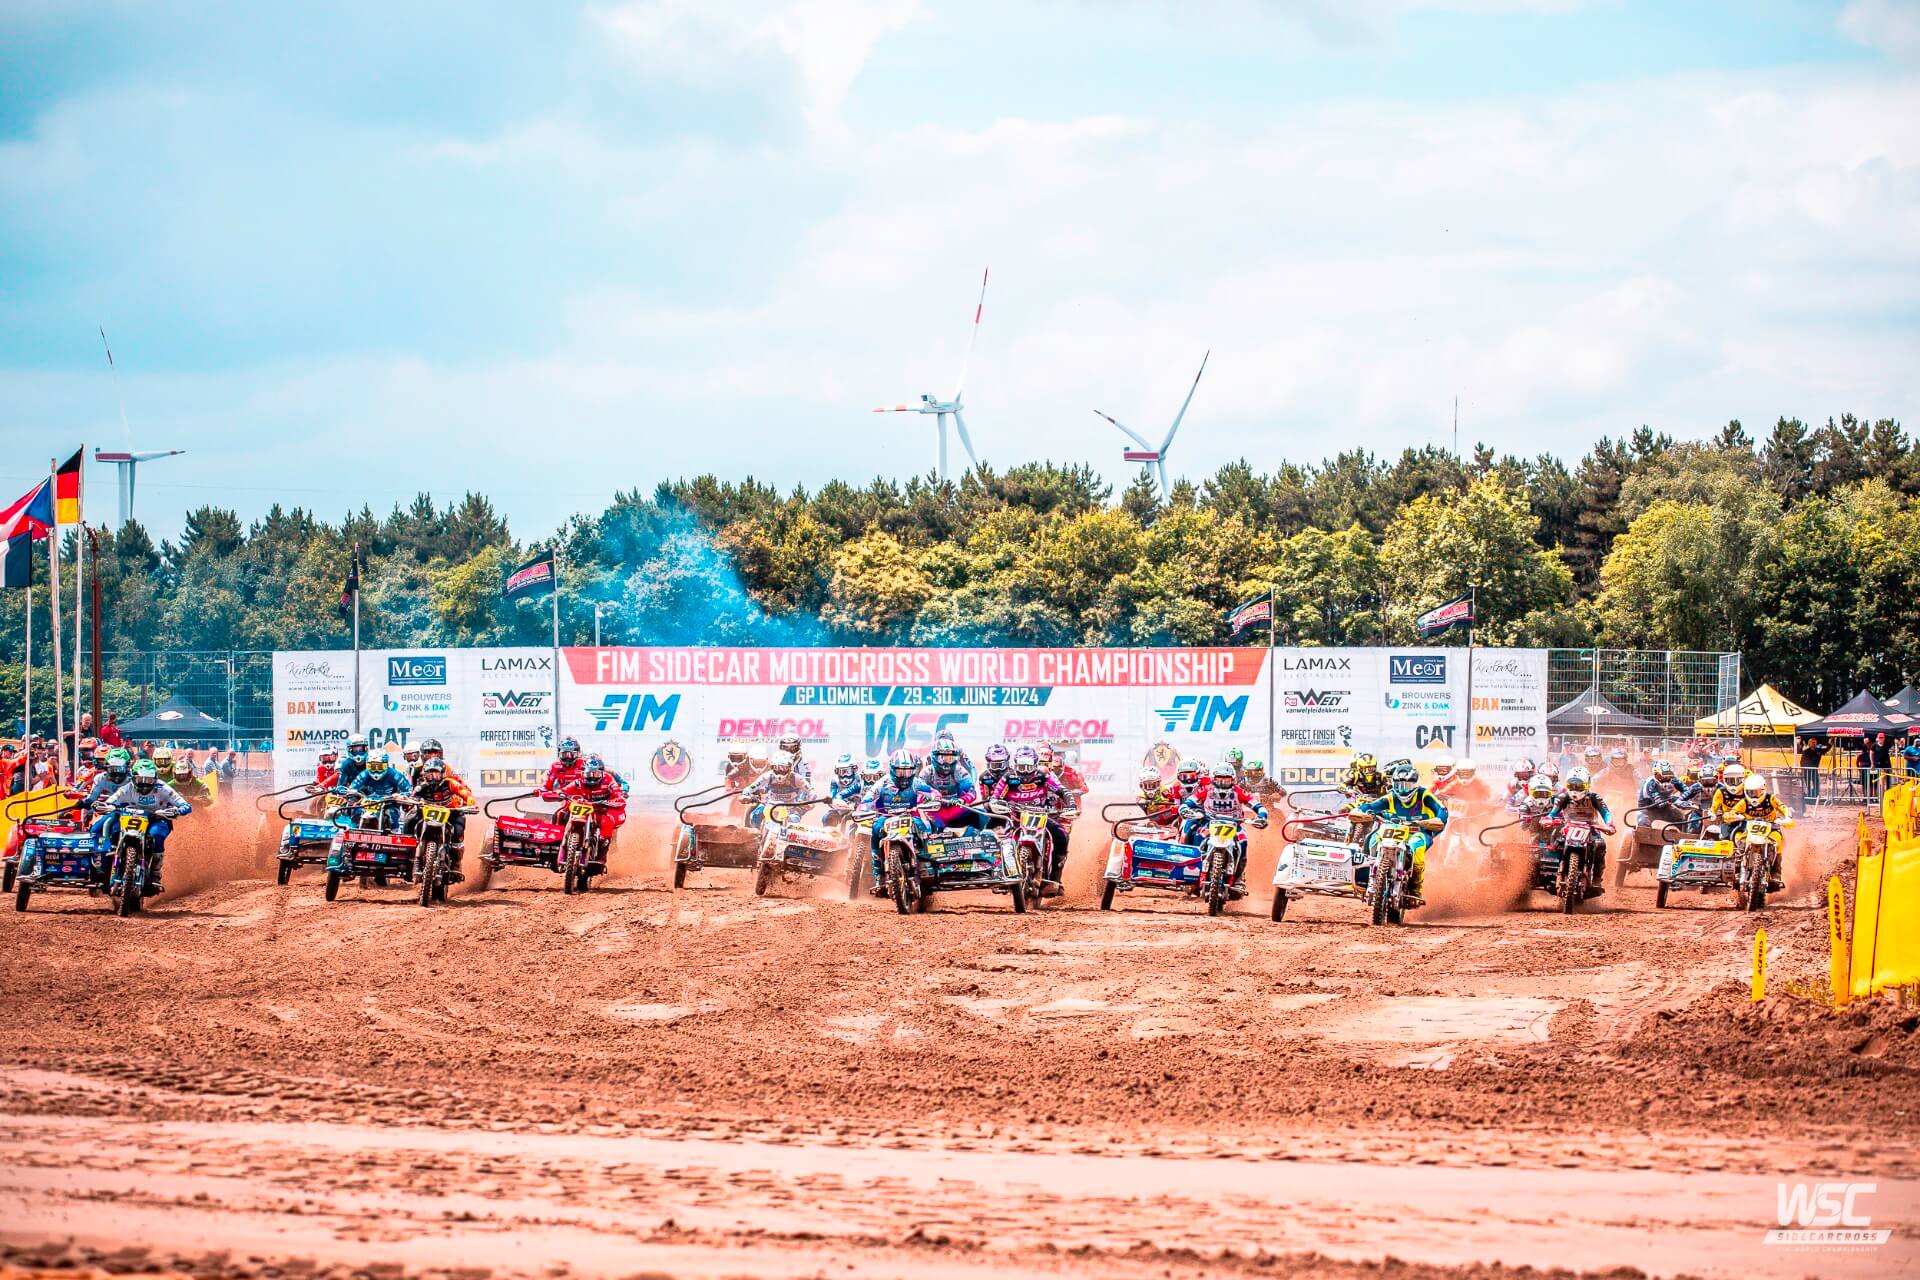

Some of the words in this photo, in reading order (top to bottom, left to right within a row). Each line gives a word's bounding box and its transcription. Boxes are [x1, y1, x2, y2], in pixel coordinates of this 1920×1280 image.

[482, 657, 551, 670] LAMAX
[597, 651, 640, 682] FIM
[650, 651, 760, 683] SIDECAR
[769, 651, 930, 684] MOTOCROSS
[939, 652, 1029, 684] WORLD
[1038, 652, 1234, 685] CHAMPIONSHIP
[1284, 658, 1351, 670] LAMAX
[401, 693, 452, 701] BROUWERS
[796, 687, 815, 704] GP
[819, 687, 876, 704] LOMMEL
[903, 687, 955, 704] 29.-30.
[960, 687, 997, 704] JUNE
[1001, 687, 1039, 704] 2024
[1402, 692, 1451, 700] BROUWERS
[288, 701, 316, 714] BAX
[401, 704, 422, 712] ZINK
[432, 703, 451, 711] DAK
[1472, 697, 1499, 710] BAX
[584, 694, 681, 731] FIM
[1154, 695, 1250, 732] FIM
[288, 730, 349, 741] JAMAPRO
[480, 730, 511, 741] PERFECT
[512, 730, 536, 741] FINISH
[1281, 729, 1311, 740] PERFECT
[1313, 729, 1336, 740] FINISH
[1416, 724, 1456, 749] CAT
[1477, 726, 1536, 736] JAMAPRO
[369, 727, 410, 750] CAT
[427, 809, 446, 822] 91
[572, 805, 592, 816] 97
[127, 818, 143, 831] 9
[885, 818, 911, 833] 199
[1214, 825, 1235, 836] 17
[1750, 824, 1768, 834] 94
[1383, 828, 1406, 840] 82
[1566, 827, 1590, 843] 101
